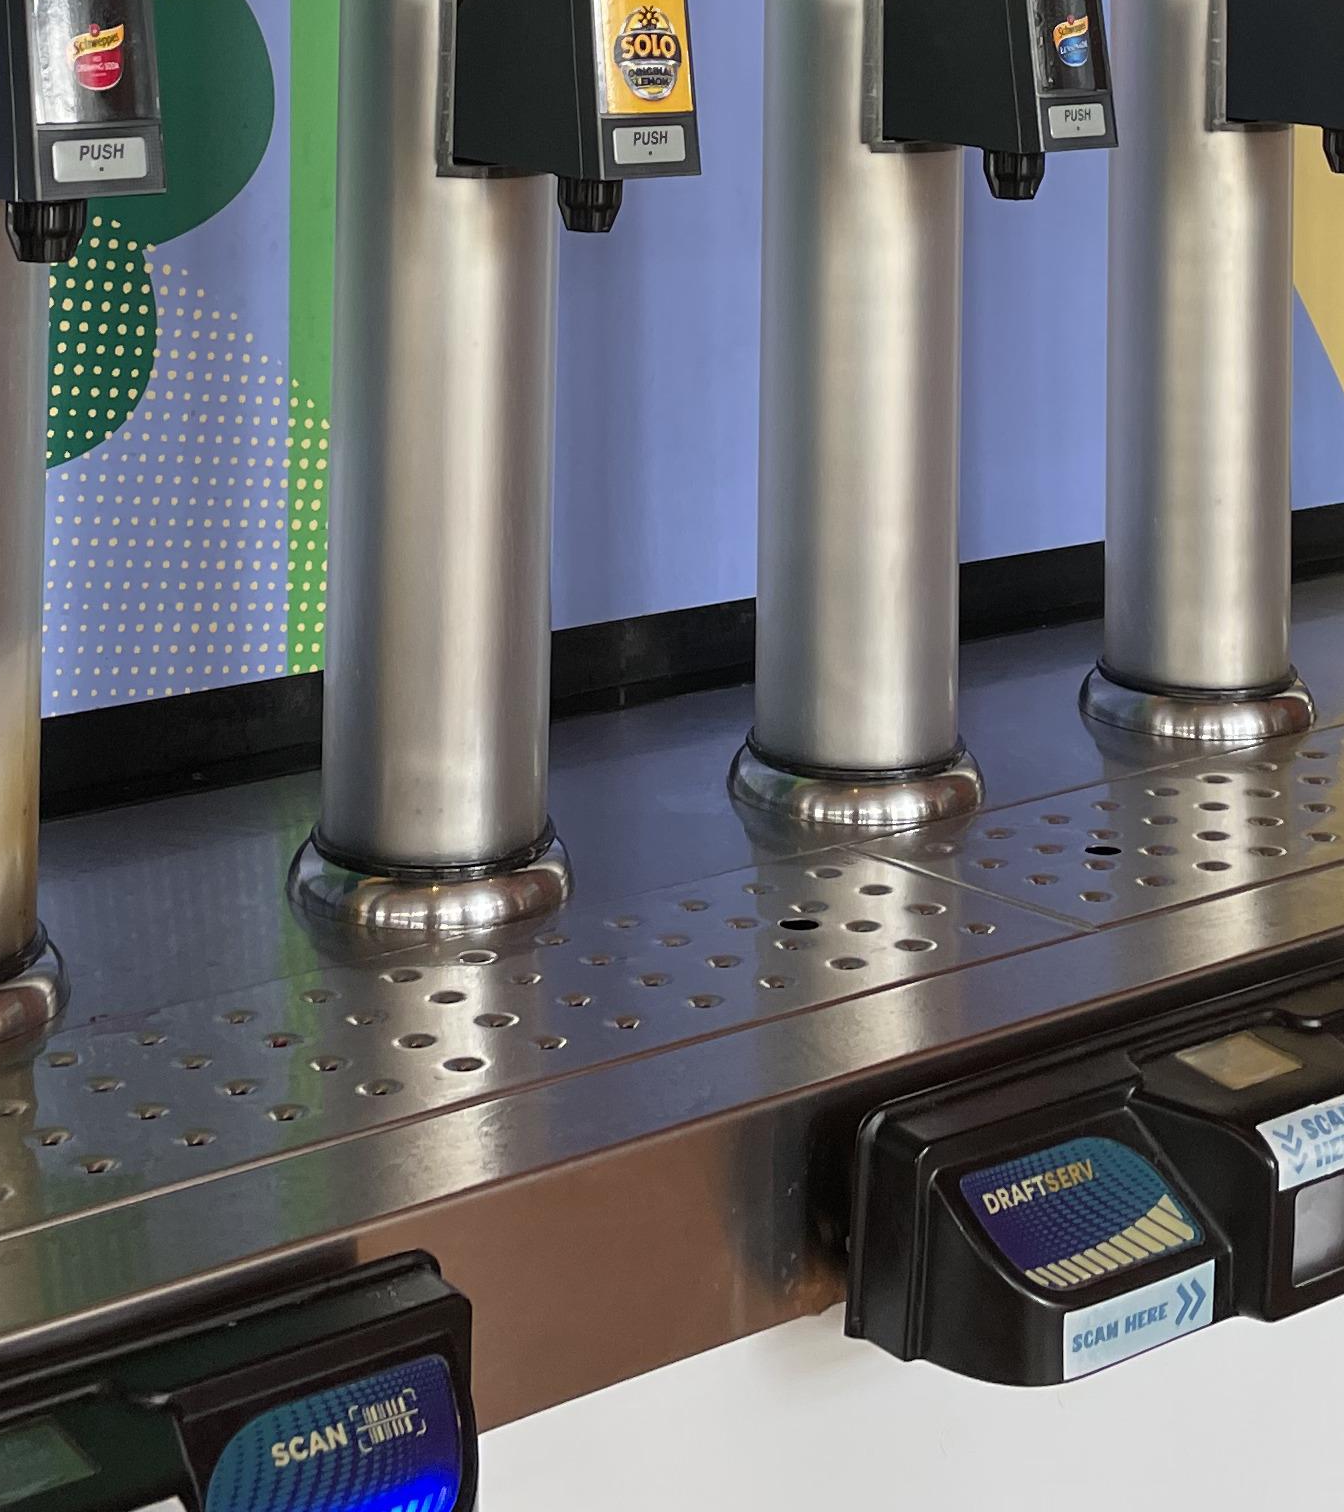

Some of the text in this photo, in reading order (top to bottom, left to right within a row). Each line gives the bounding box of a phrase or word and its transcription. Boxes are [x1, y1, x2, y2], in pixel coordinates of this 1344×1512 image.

[621, 34, 676, 59] SOLO
[1065, 109, 1091, 122] PUSH
[633, 131, 668, 146] PUSH
[80, 143, 124, 161] PUSH
[982, 1158, 1093, 1215] DRAFTSERV
[1072, 1302, 1168, 1353] SCAN HERE
[271, 1422, 348, 1467] SCAN
